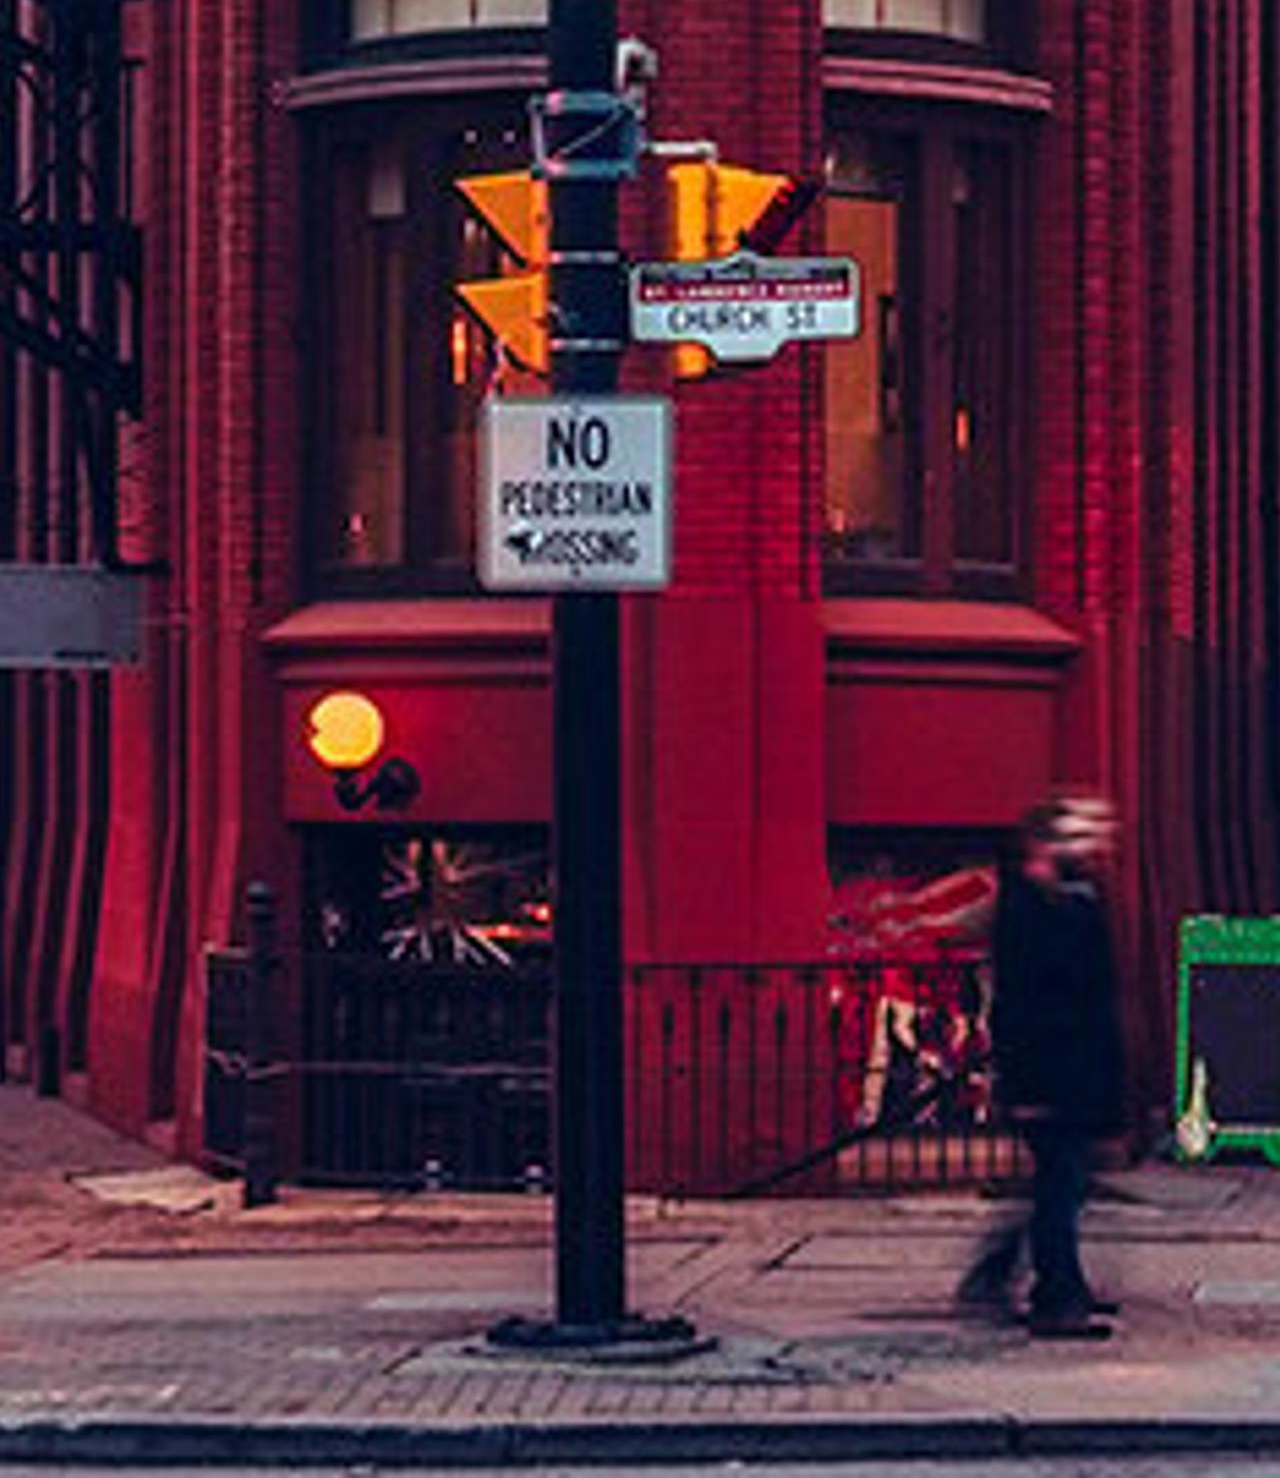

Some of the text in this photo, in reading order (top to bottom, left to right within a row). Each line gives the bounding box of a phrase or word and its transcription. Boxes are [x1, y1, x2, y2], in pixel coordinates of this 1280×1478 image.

[668, 301, 818, 335] CHURCH ST
[547, 417, 611, 471] NO
[501, 480, 653, 517] PEDESTRIAN
[505, 528, 640, 565] OSSING
